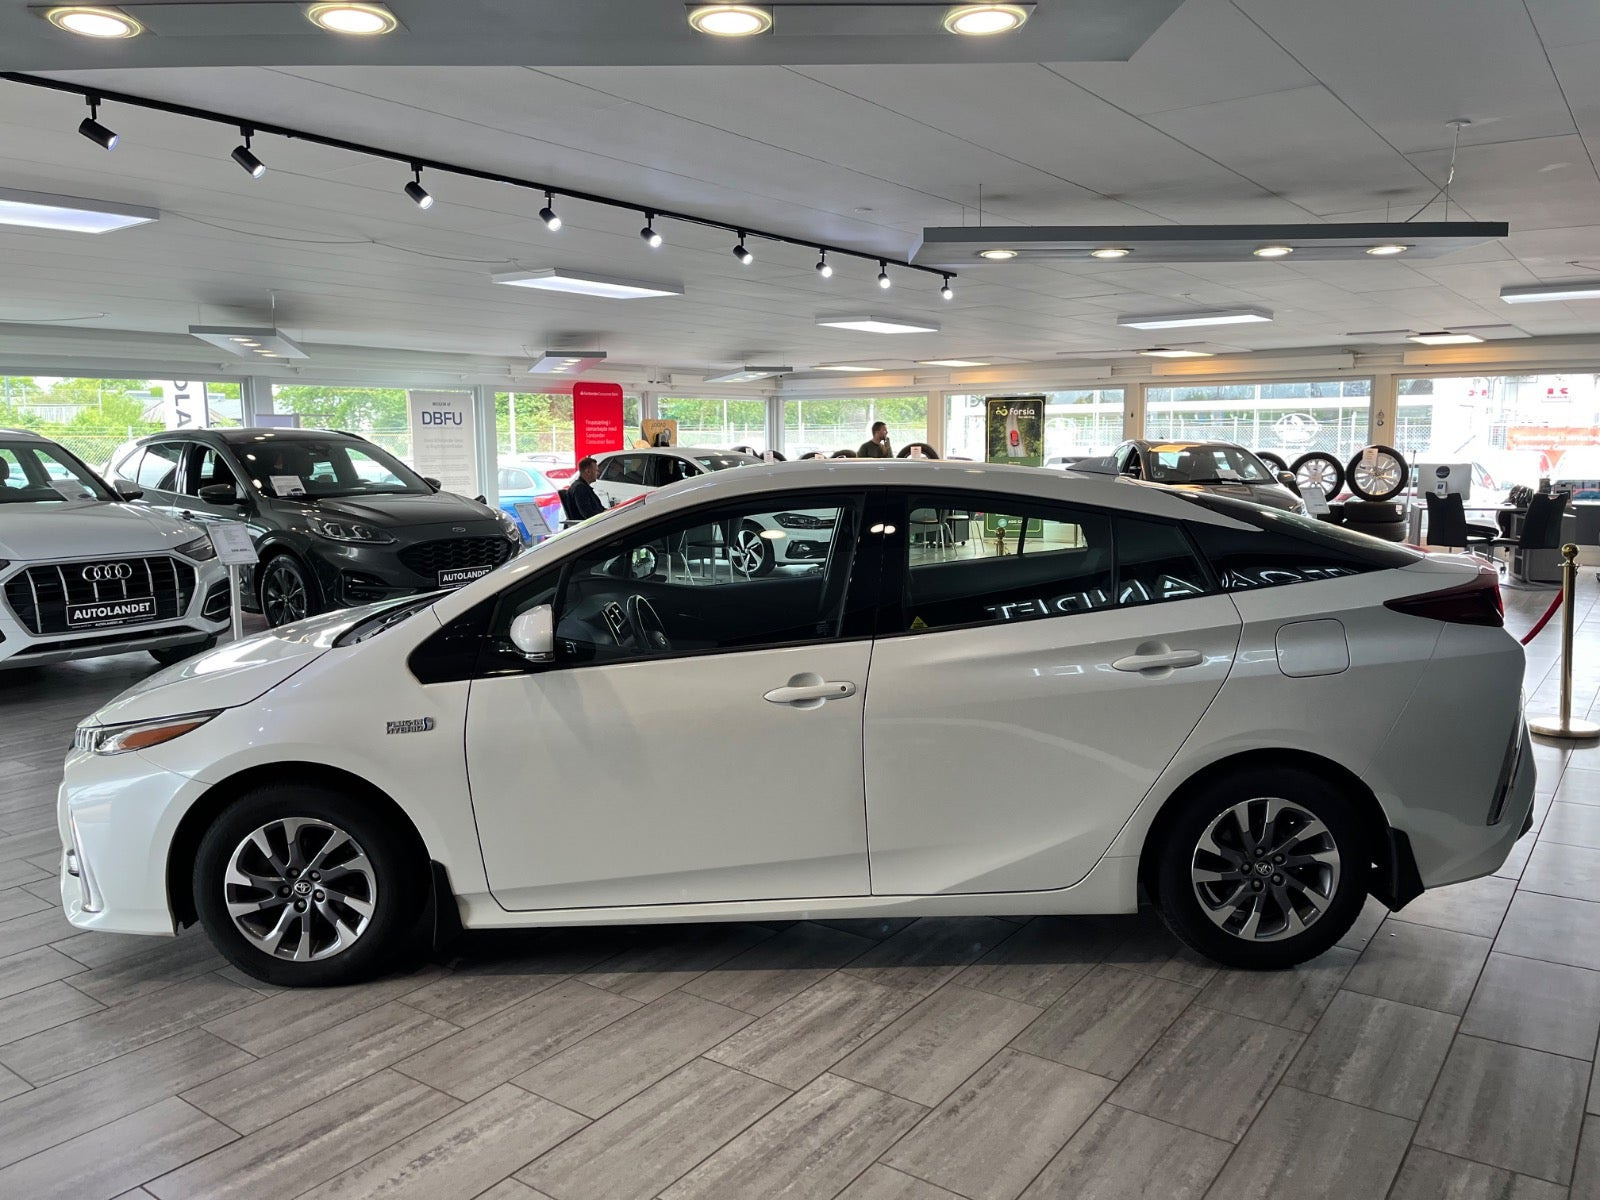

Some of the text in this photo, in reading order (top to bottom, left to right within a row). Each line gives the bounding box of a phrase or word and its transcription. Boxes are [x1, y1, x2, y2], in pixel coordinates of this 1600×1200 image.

[421, 411, 463, 425] DBFU
[73, 602, 151, 620] AUTOLANDET
[386, 726, 424, 735] HYBRID
